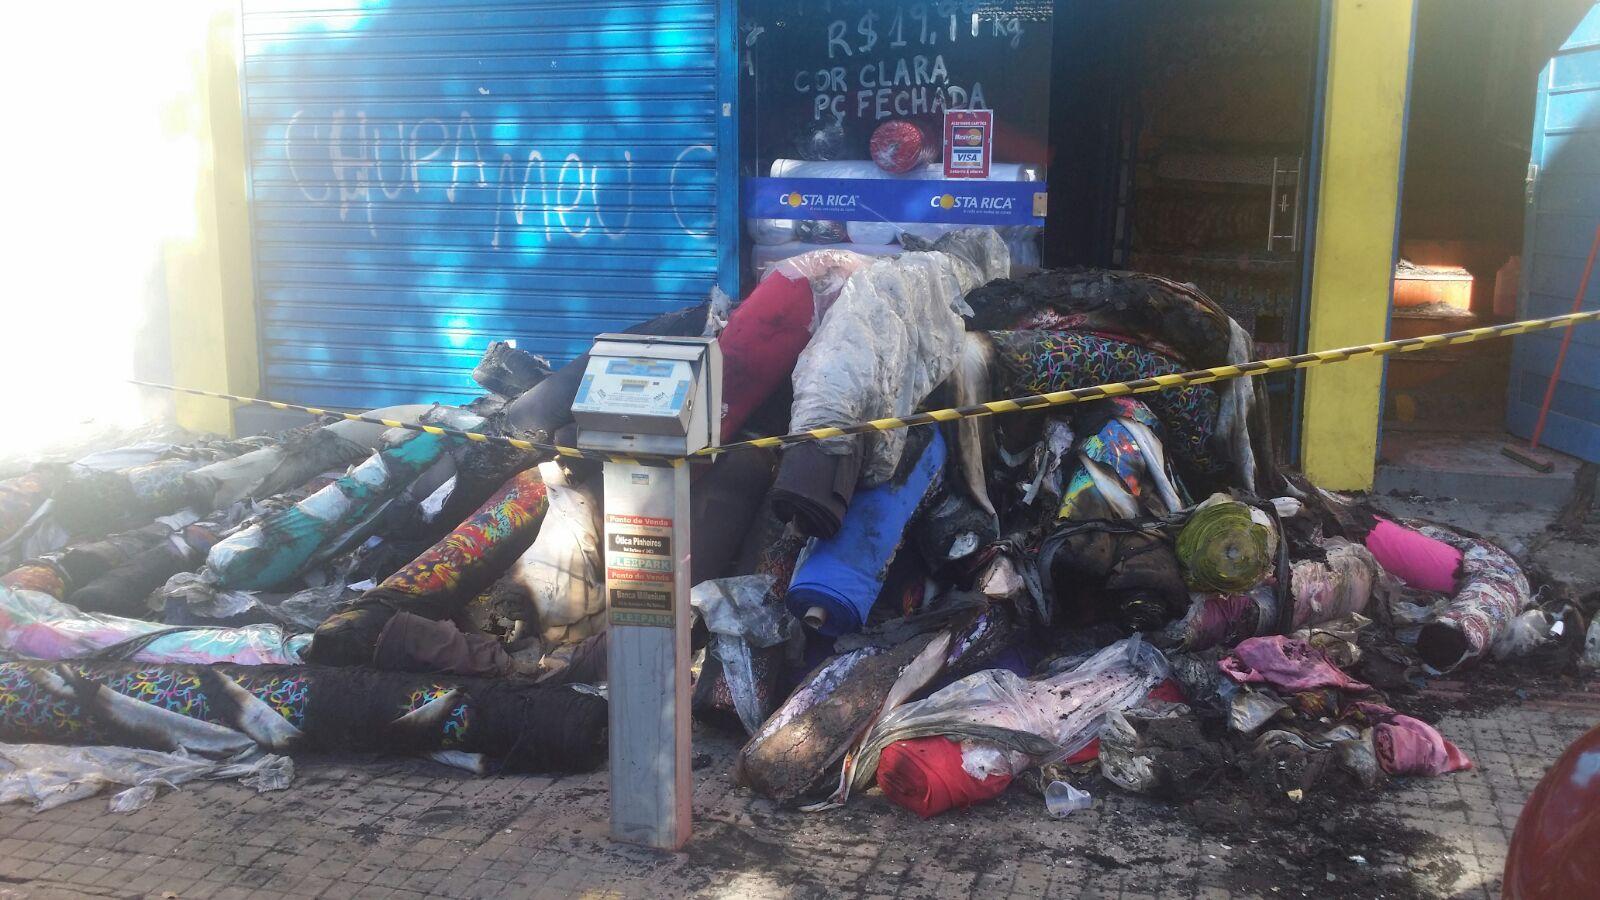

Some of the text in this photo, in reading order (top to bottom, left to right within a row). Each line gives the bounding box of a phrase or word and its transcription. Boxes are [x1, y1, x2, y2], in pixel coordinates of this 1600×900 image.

[794, 54, 949, 92] COR CLARA
[857, 81, 988, 120] FECHADA
[957, 153, 978, 162] VISA
[286, 109, 488, 238] CHUPA
[780, 192, 856, 208] COSTA RICA
[930, 194, 1012, 209] COSTA RICA
[644, 518, 669, 527] Venda
